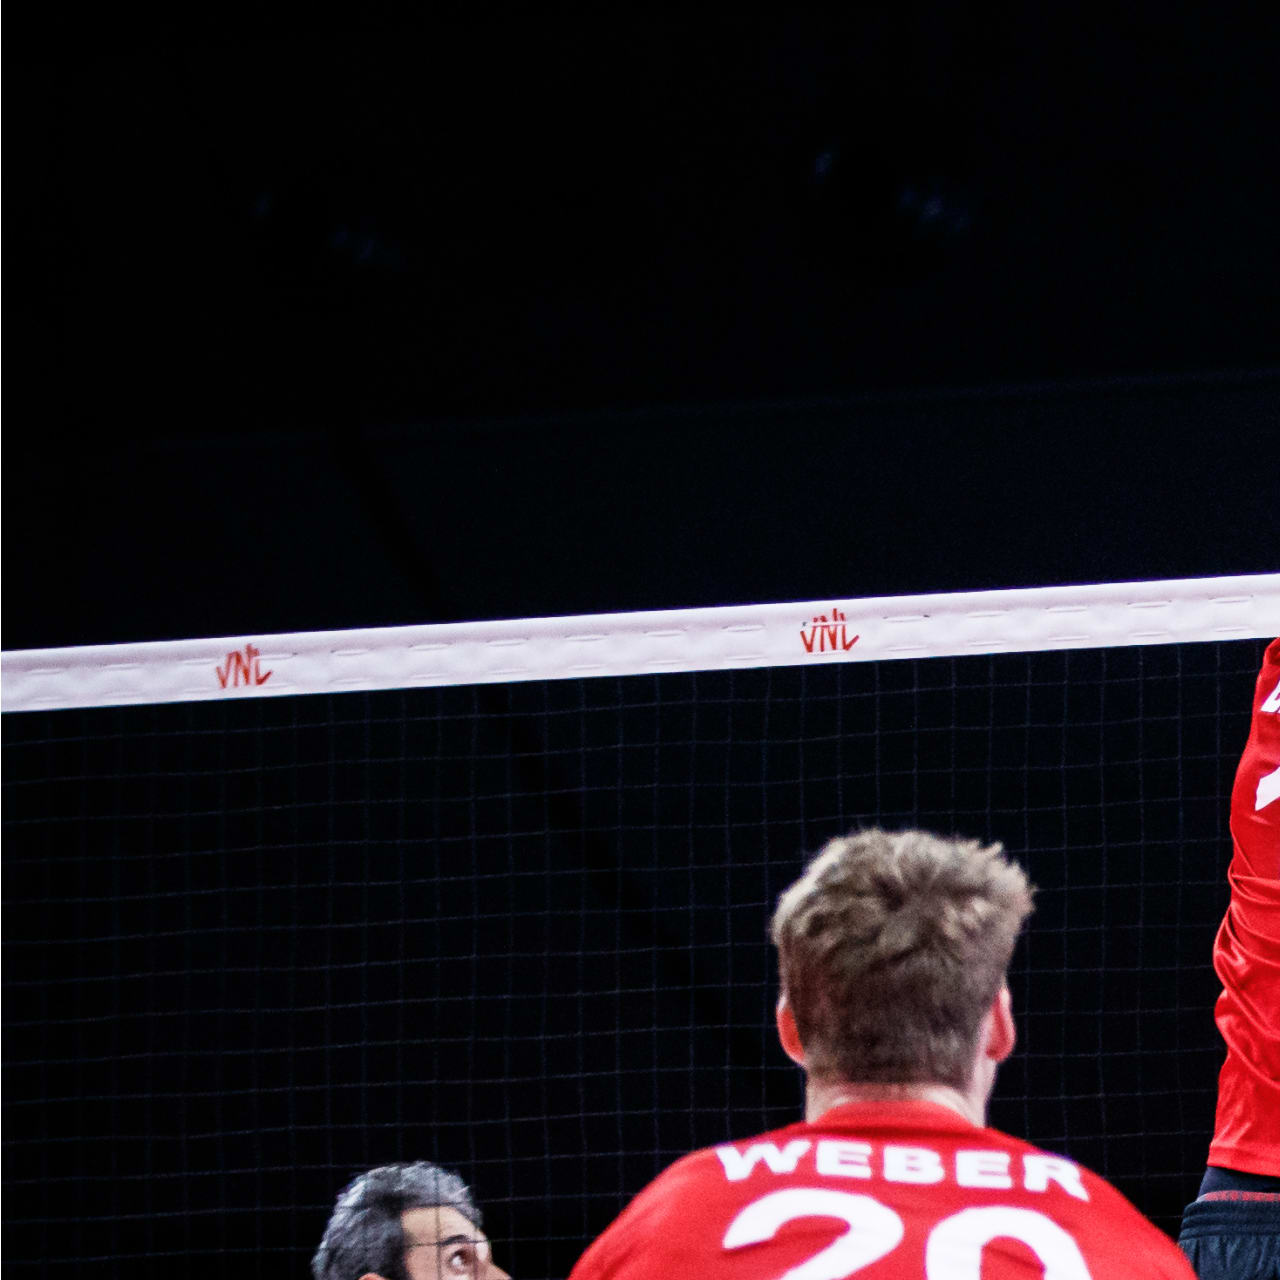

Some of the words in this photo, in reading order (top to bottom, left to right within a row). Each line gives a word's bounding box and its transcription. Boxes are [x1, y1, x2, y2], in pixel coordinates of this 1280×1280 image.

[799, 607, 860, 653] VNL
[215, 643, 273, 689] VNL
[715, 1138, 1091, 1203] WEBER
